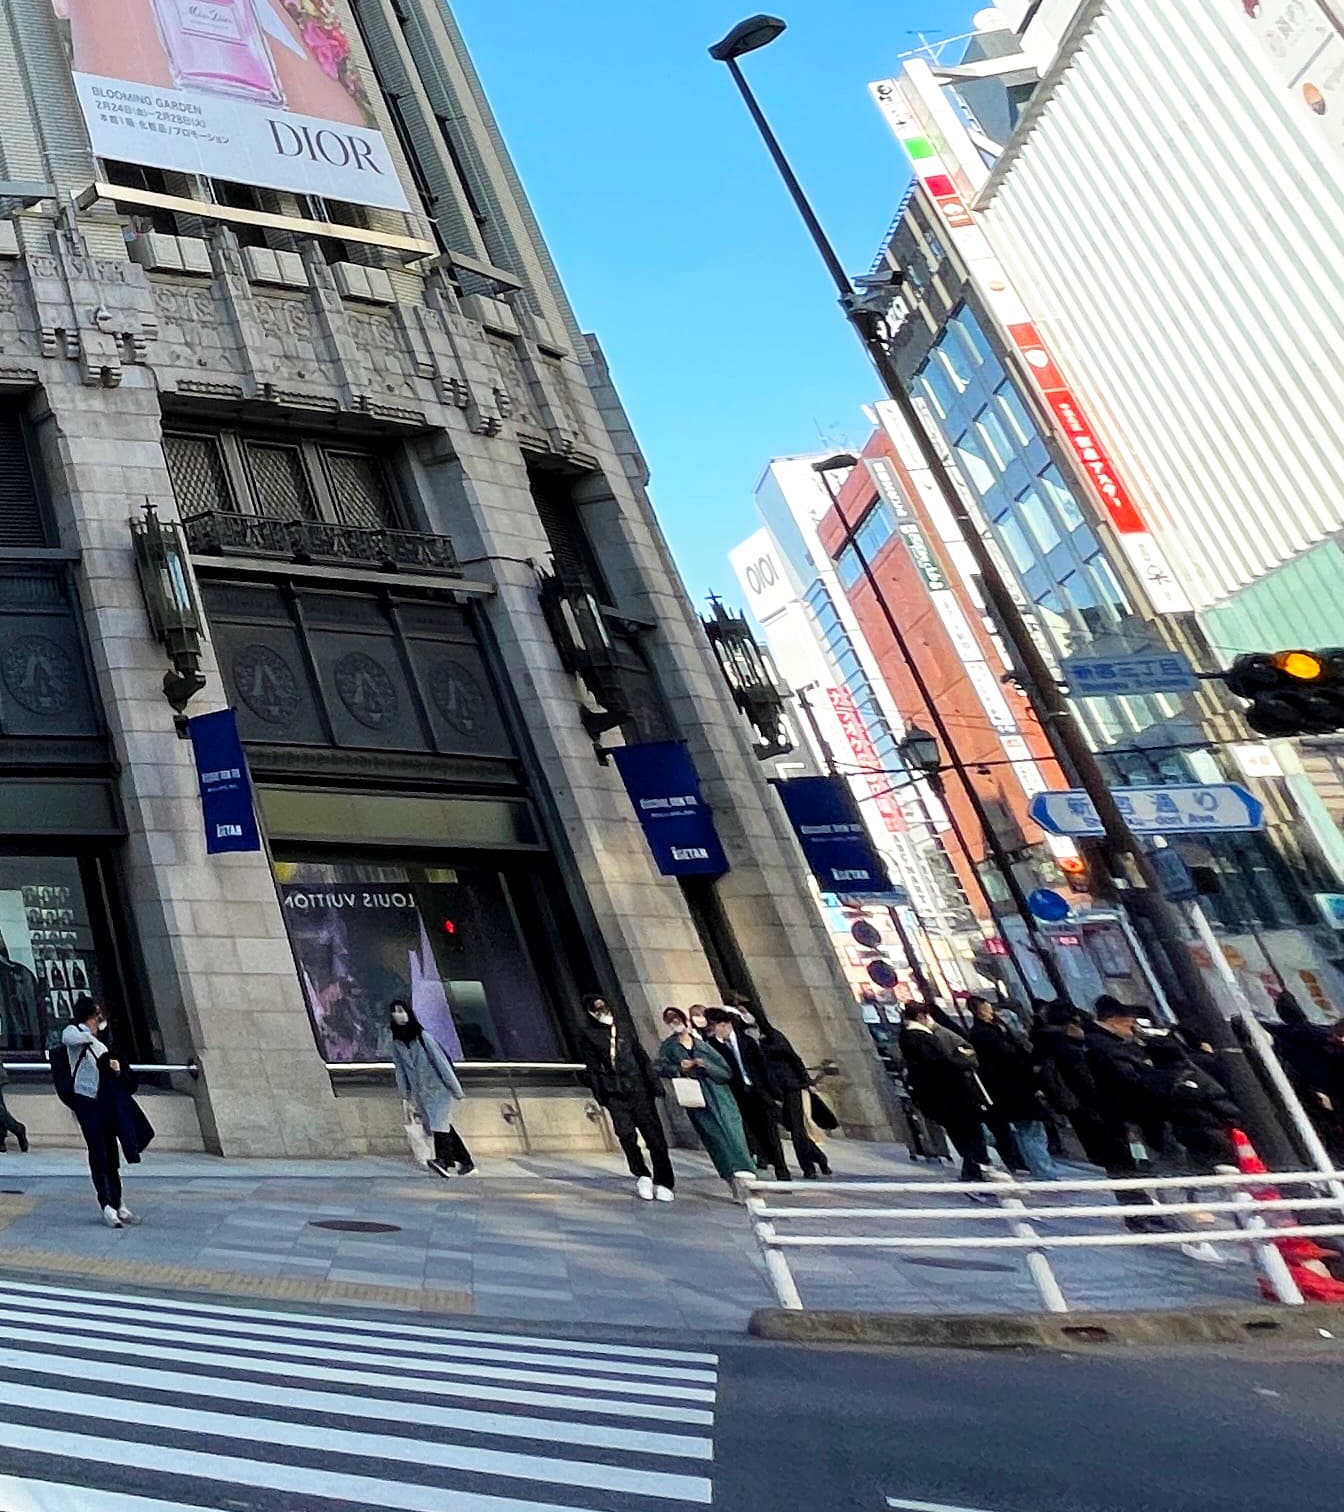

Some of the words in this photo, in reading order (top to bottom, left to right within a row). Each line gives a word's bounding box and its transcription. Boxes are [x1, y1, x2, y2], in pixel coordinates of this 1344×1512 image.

[91, 86, 152, 106] BLOOMING
[155, 97, 203, 116] GARDEN
[264, 118, 385, 176] DIOR
